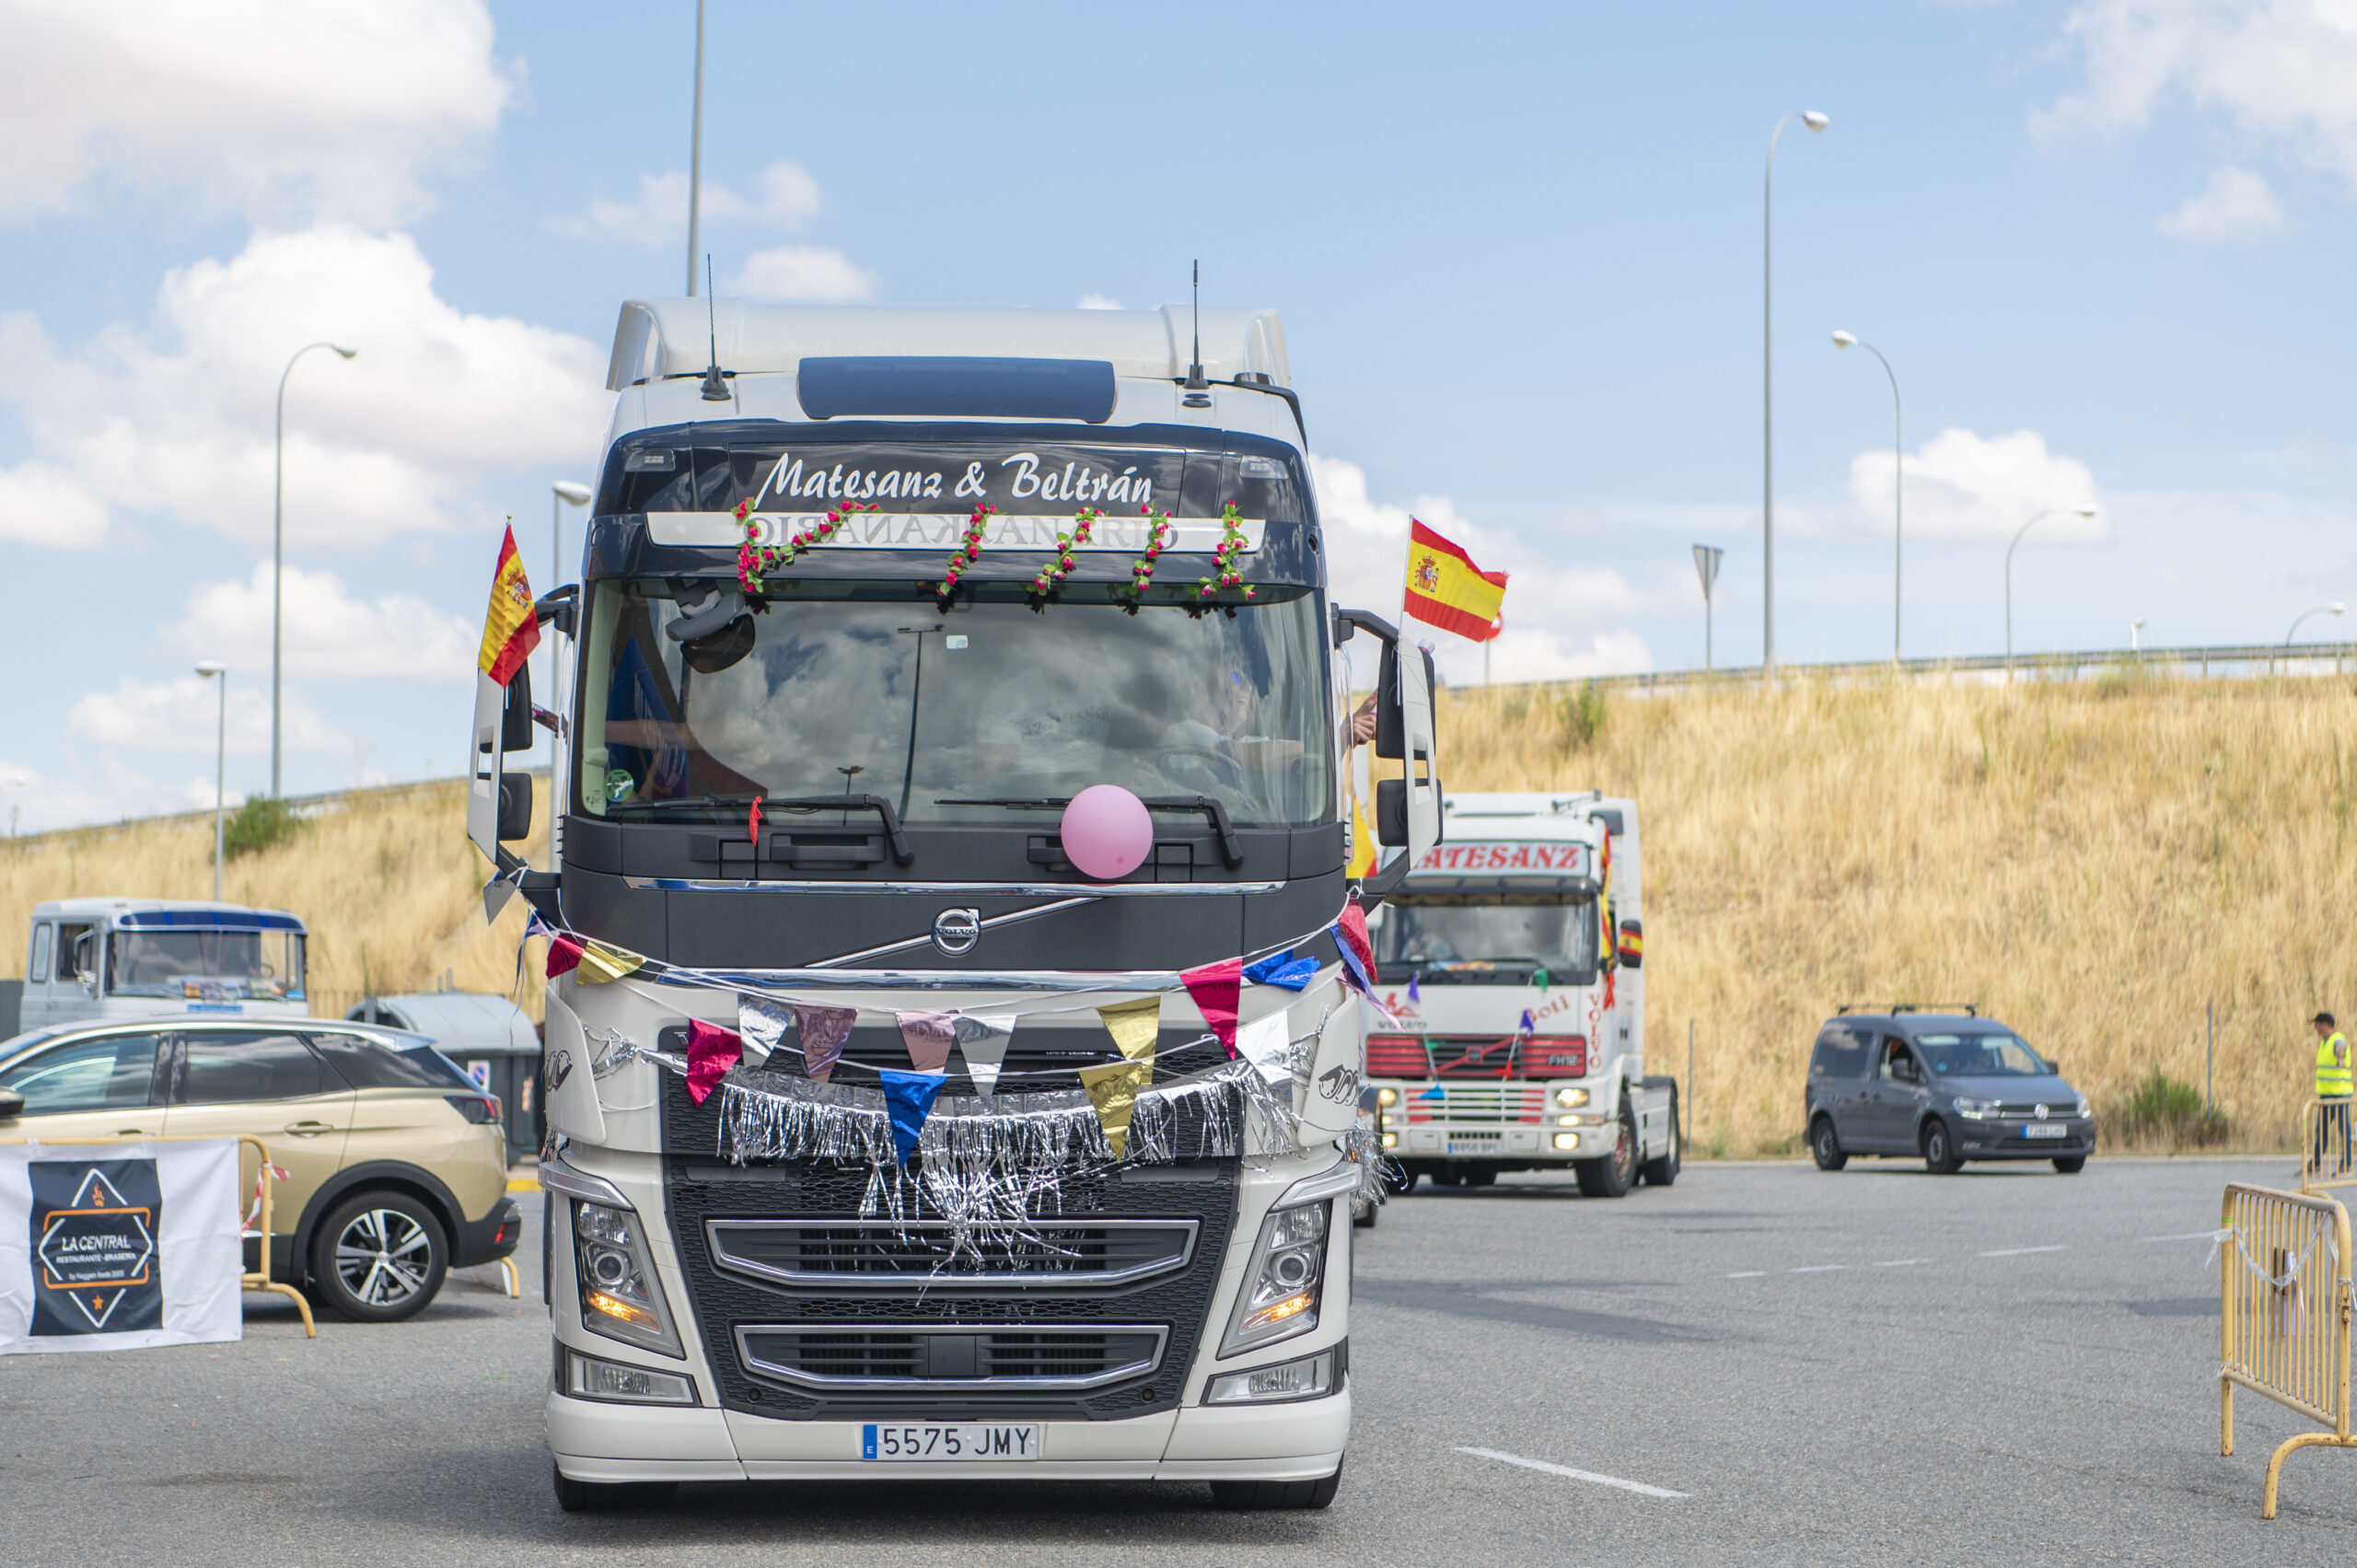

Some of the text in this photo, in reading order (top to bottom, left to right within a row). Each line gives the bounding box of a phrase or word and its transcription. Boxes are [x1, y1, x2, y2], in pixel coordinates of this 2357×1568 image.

[752, 452, 1151, 510] Matesanz & Beltrán
[1411, 844, 1580, 870] ATESANZ
[937, 928, 977, 936] VOLVO
[62, 1235, 131, 1251] LA CENTRAL
[866, 1428, 1031, 1455] E 5575 JMY
